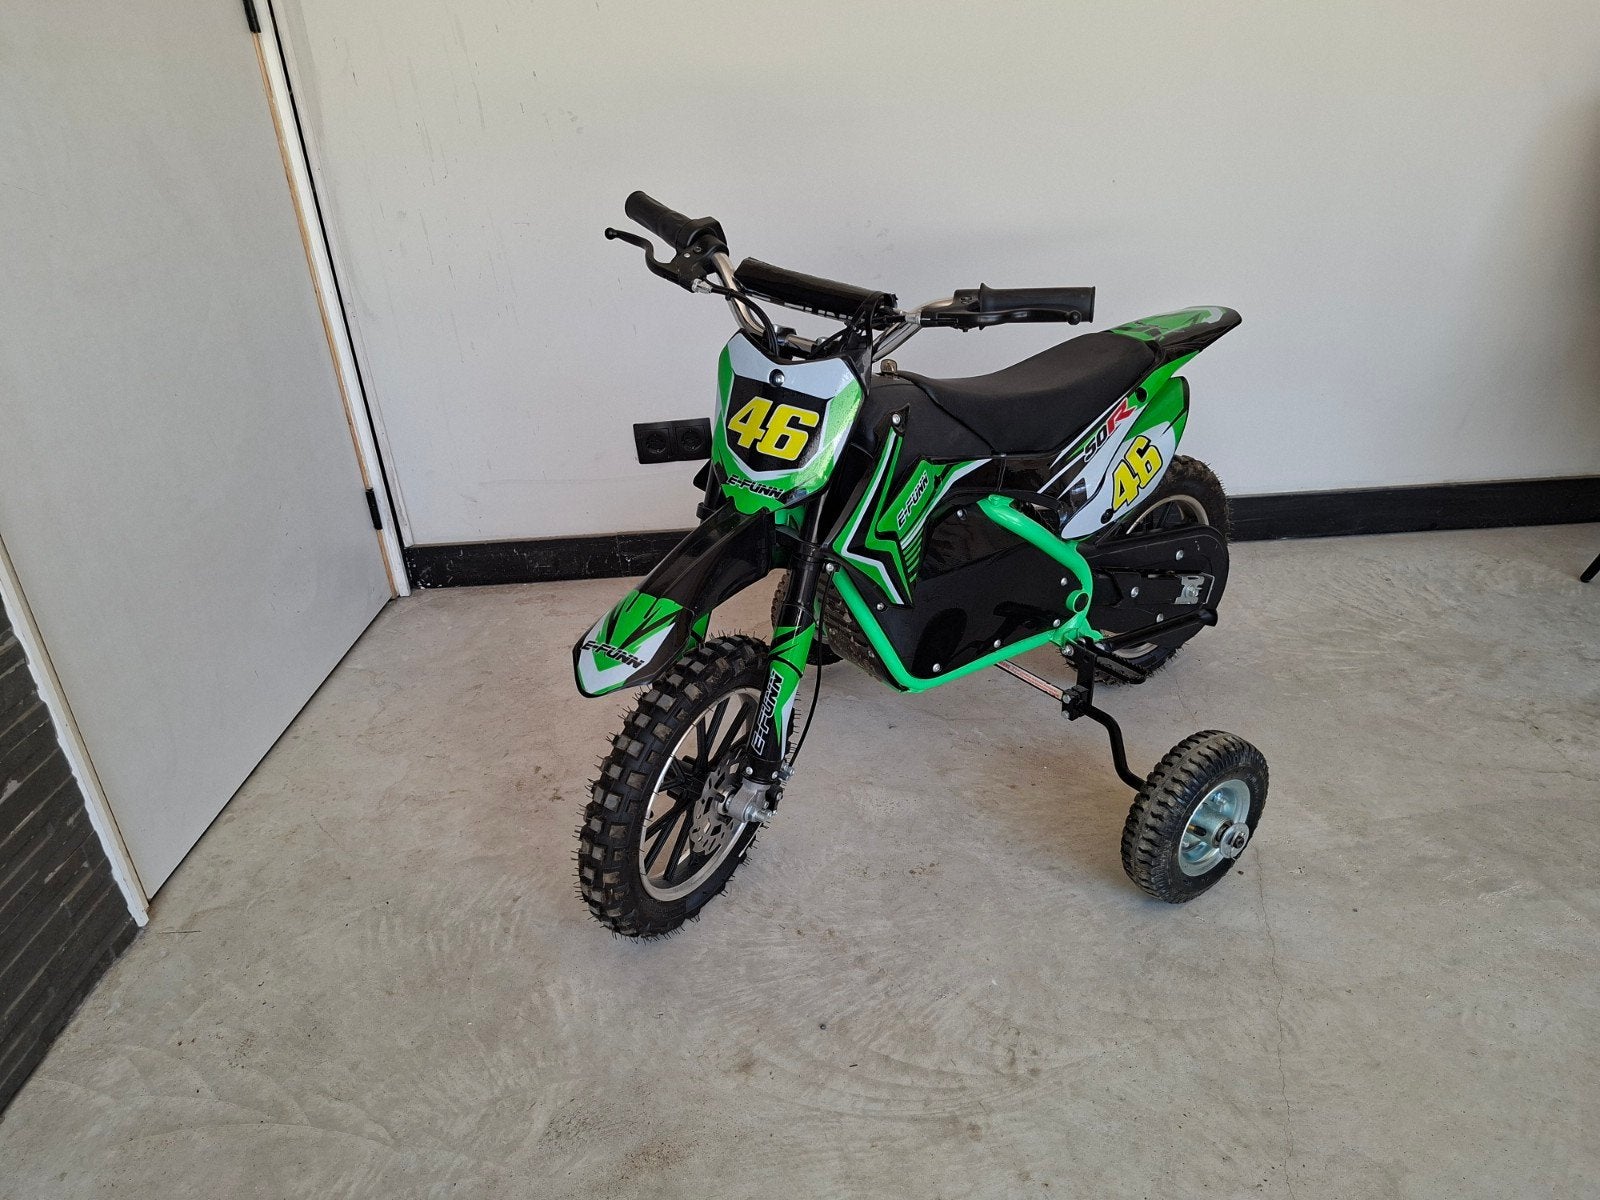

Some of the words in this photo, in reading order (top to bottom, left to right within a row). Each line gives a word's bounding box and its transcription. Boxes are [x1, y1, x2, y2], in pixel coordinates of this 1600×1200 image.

[728, 396, 819, 461] 46
[1084, 397, 1137, 463] 50R
[726, 474, 784, 499] E-FUNN
[897, 470, 929, 531] E-FUNN
[1112, 435, 1163, 513] 46
[581, 640, 645, 669] E-FUNN
[750, 667, 784, 756] E-FUNN
